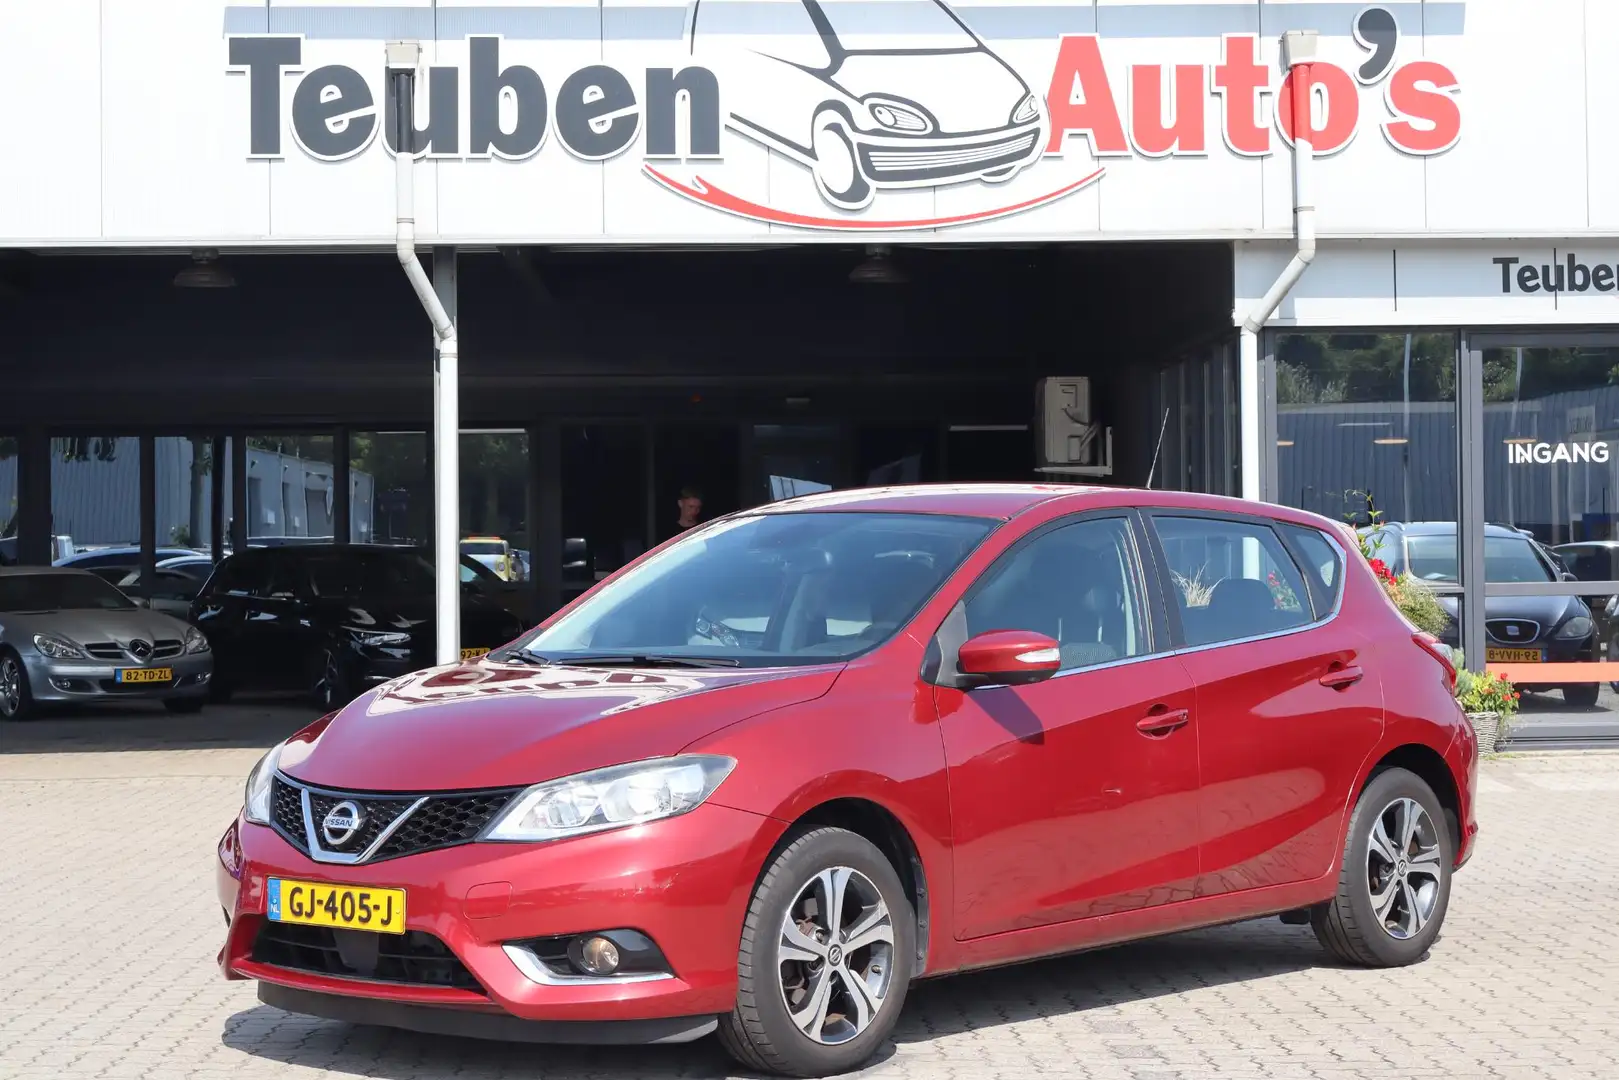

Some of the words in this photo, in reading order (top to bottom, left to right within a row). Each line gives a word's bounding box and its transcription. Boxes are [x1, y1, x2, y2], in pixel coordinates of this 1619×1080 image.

[228, 36, 720, 157] Teuben
[1043, 7, 1461, 153] Auto's
[1492, 253, 1619, 293] Teube
[1508, 442, 1609, 464] INGANG
[126, 670, 169, 681] 82-TD-ZL
[324, 817, 354, 828] NISSAN
[289, 886, 393, 926] GJ-405-J
